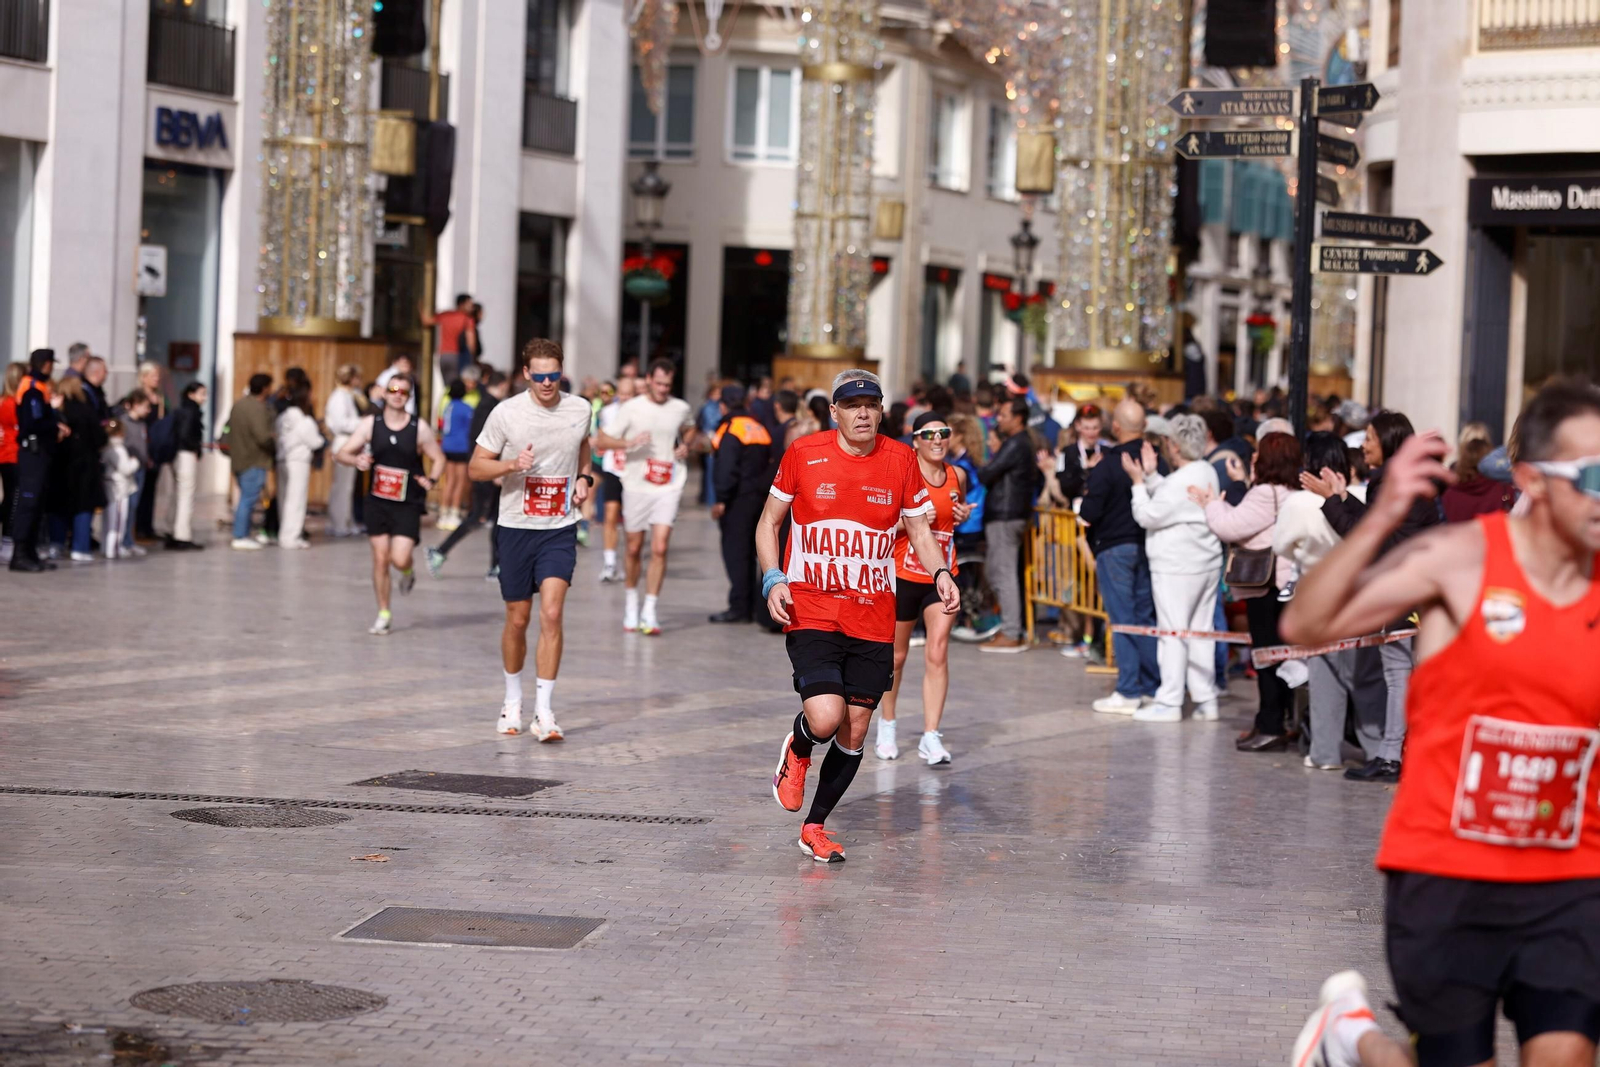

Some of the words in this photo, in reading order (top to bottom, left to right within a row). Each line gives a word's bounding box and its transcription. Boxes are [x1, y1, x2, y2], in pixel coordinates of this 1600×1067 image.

[1221, 101, 1290, 114] ATARAZANAS
[156, 106, 229, 149] BBVA
[1224, 133, 1261, 145] TEATRO
[1261, 133, 1288, 145] SOHO
[1491, 185, 1563, 210] Massimo
[1323, 218, 1354, 232] MUSEO
[1355, 219, 1367, 234] DE
[1323, 247, 1360, 260] CENTRE
[1363, 249, 1408, 262] POMPIDOU
[535, 486, 558, 495] 4186
